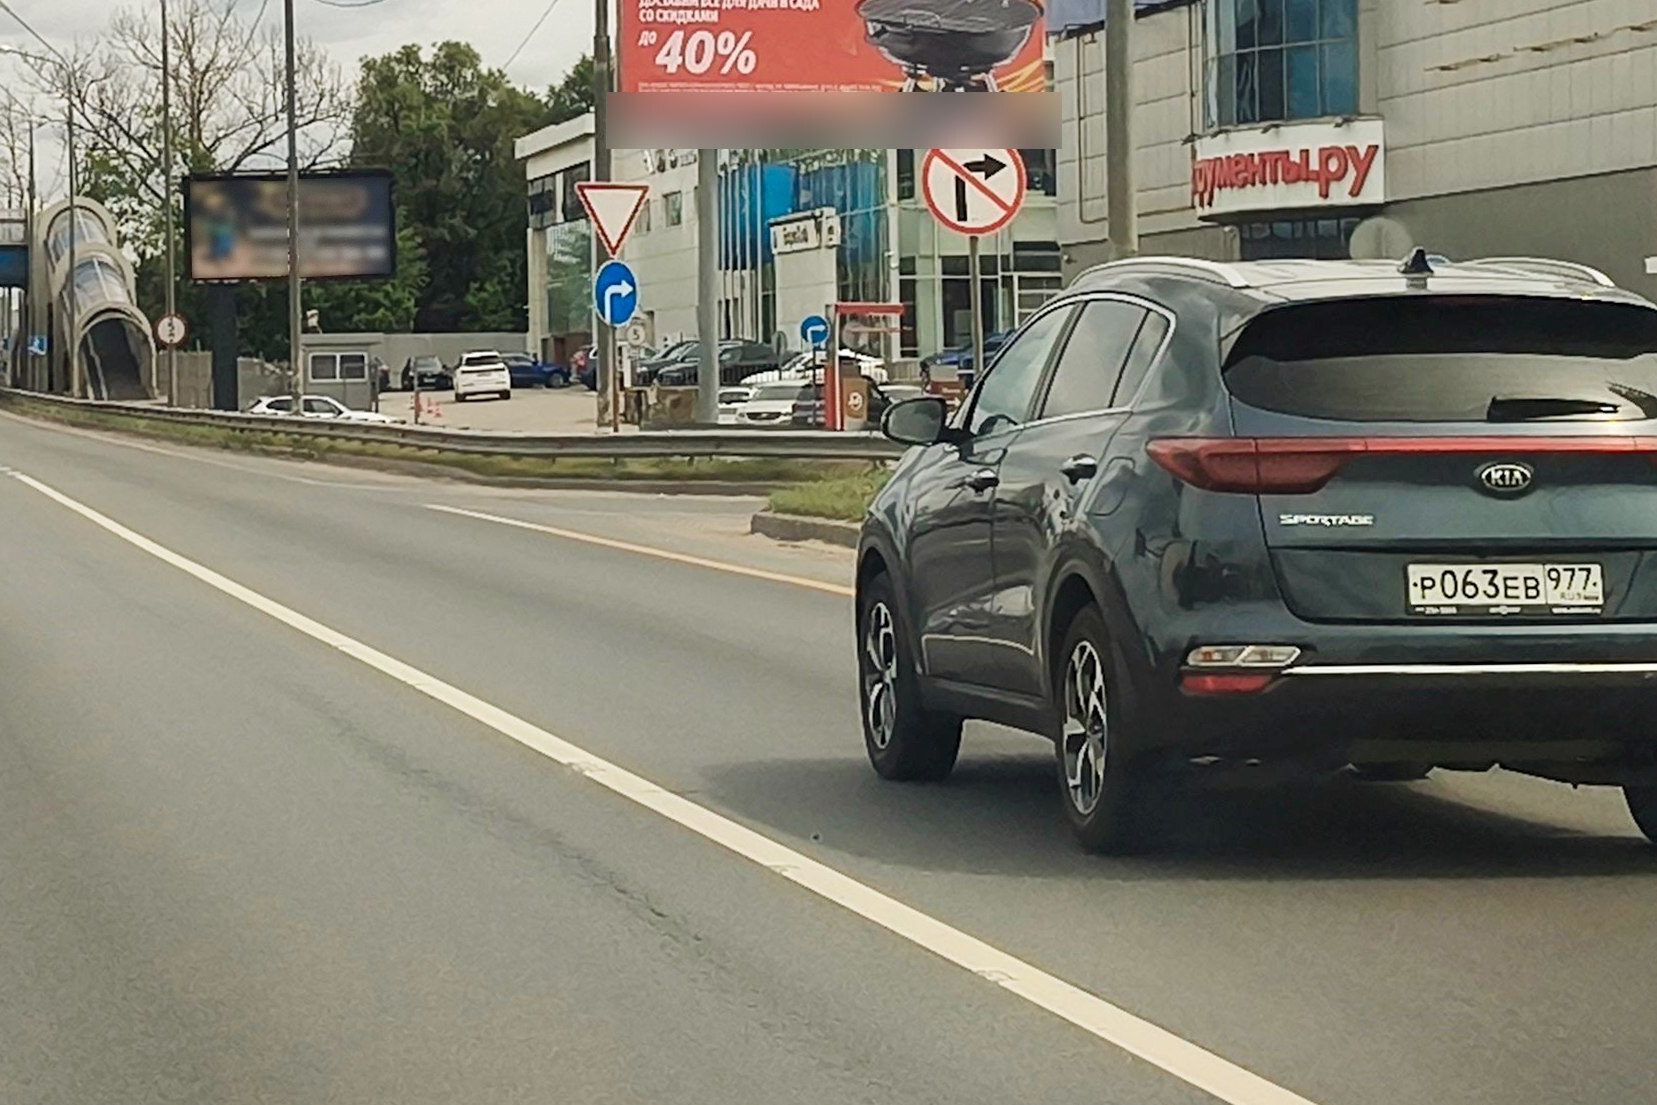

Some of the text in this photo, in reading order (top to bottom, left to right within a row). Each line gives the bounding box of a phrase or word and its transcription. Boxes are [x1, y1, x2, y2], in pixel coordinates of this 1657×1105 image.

[639, 8, 719, 25] СО СКИДКАМИ
[655, 30, 757, 75] 40%
[1491, 470, 1525, 485] KIA
[1279, 514, 1374, 526] SPORTAGE
